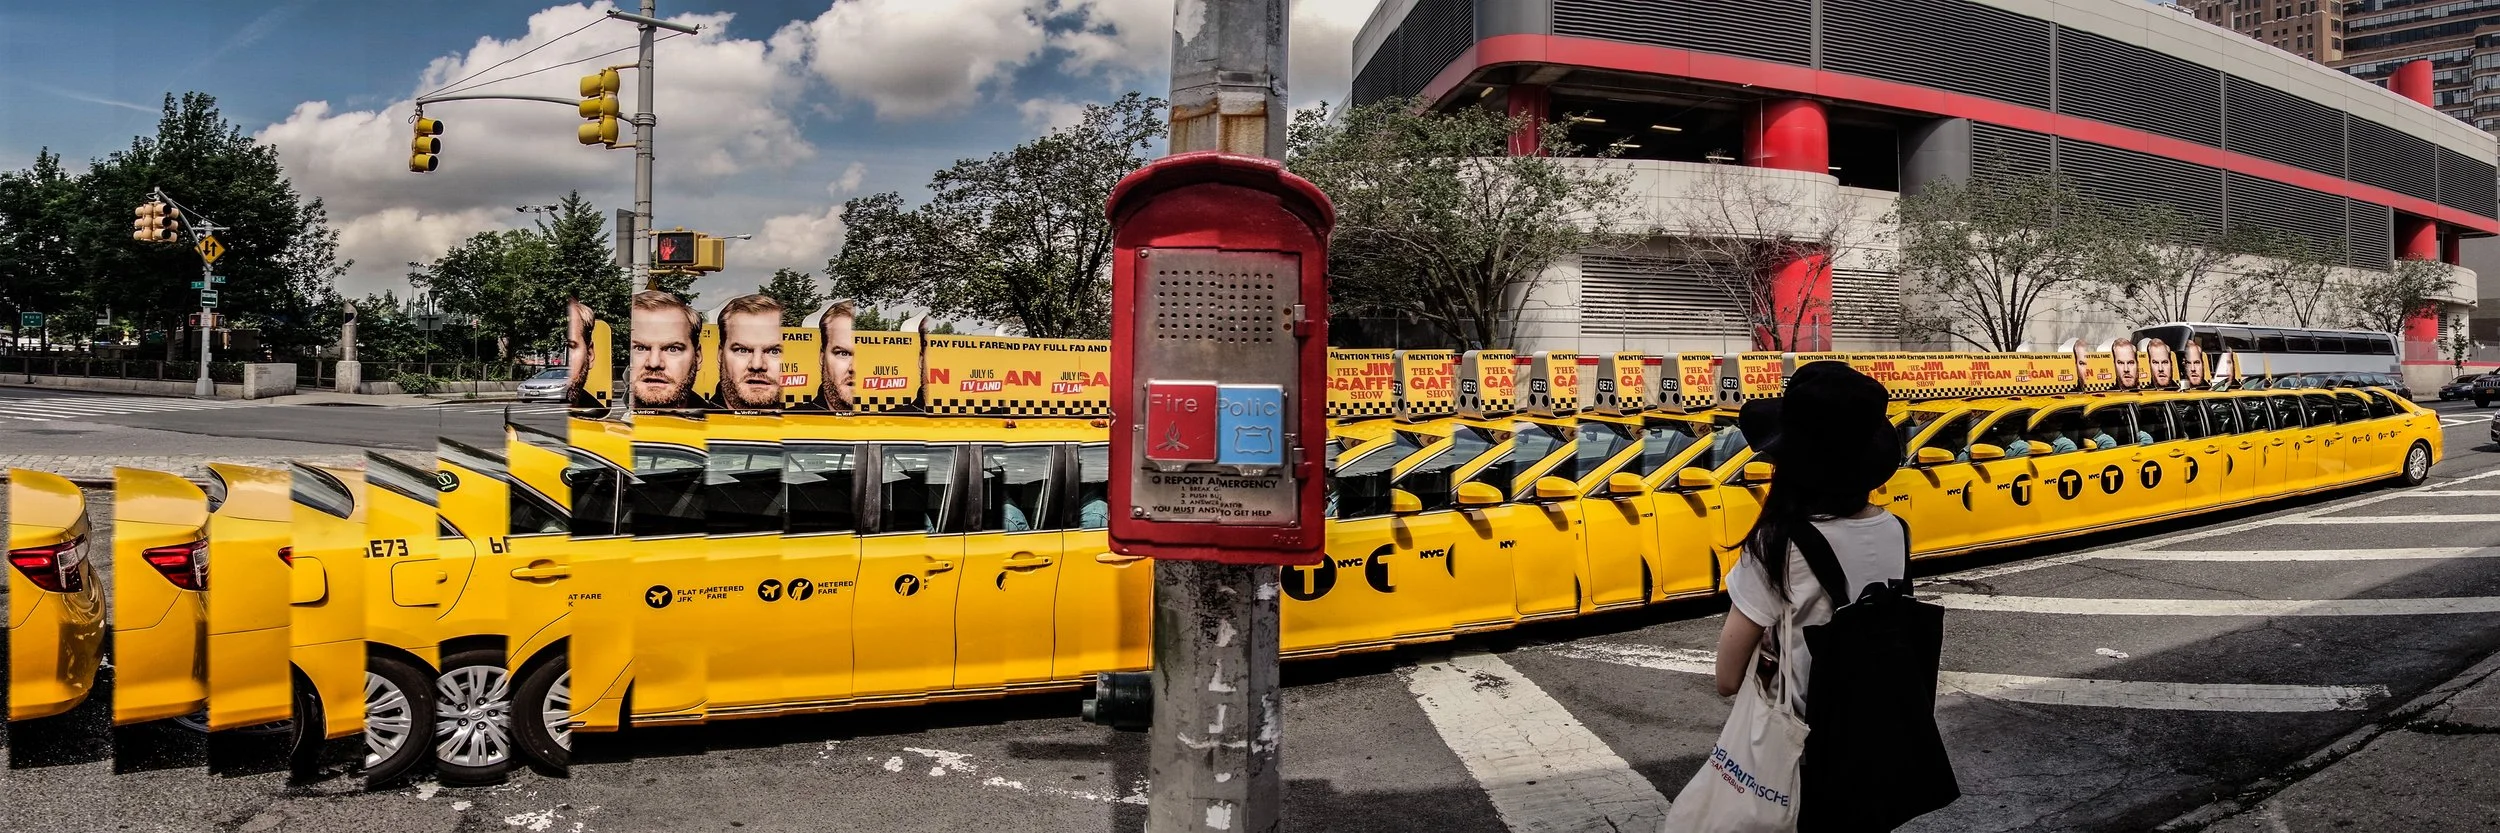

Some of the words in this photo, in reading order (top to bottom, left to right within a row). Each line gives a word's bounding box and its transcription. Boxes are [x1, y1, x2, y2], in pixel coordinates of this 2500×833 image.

[782, 333, 813, 341] FARE!
[854, 336, 881, 345] FULL
[883, 337, 912, 345] FARE!
[930, 340, 950, 348] PAY
[952, 340, 977, 348] FULL
[1023, 343, 1040, 351] PAY
[1043, 344, 1067, 352] FULL
[873, 366, 890, 375] JULY
[891, 366, 898, 375] 15
[1485, 367, 1506, 375] THE
[1870, 361, 1895, 371] JIM
[1920, 361, 1944, 371] JIM
[1969, 361, 1990, 371] JIM
[970, 369, 987, 378] JULY
[987, 369, 994, 378] 15
[1061, 372, 1077, 380] JULY
[1411, 367, 1434, 376] THE
[865, 378, 878, 387] TV
[880, 378, 906, 388] LAND
[962, 382, 975, 390] TV
[976, 381, 1001, 391] LAND
[1053, 383, 1065, 392] TV
[1463, 381, 1477, 392] 6E73
[1532, 380, 1546, 391] 6E73
[1599, 380, 1614, 391] 6E73
[1663, 379, 1677, 390] 6E73
[1723, 378, 1738, 389] 6E73
[1350, 391, 1383, 399] SHOW
[1151, 393, 1198, 412] Fire
[1164, 476, 1204, 485] REPORT
[1500, 540, 1517, 549] NY
[1420, 549, 1445, 559] NYC
[1337, 557, 1364, 568] NYC
[707, 585, 744, 593] METERED
